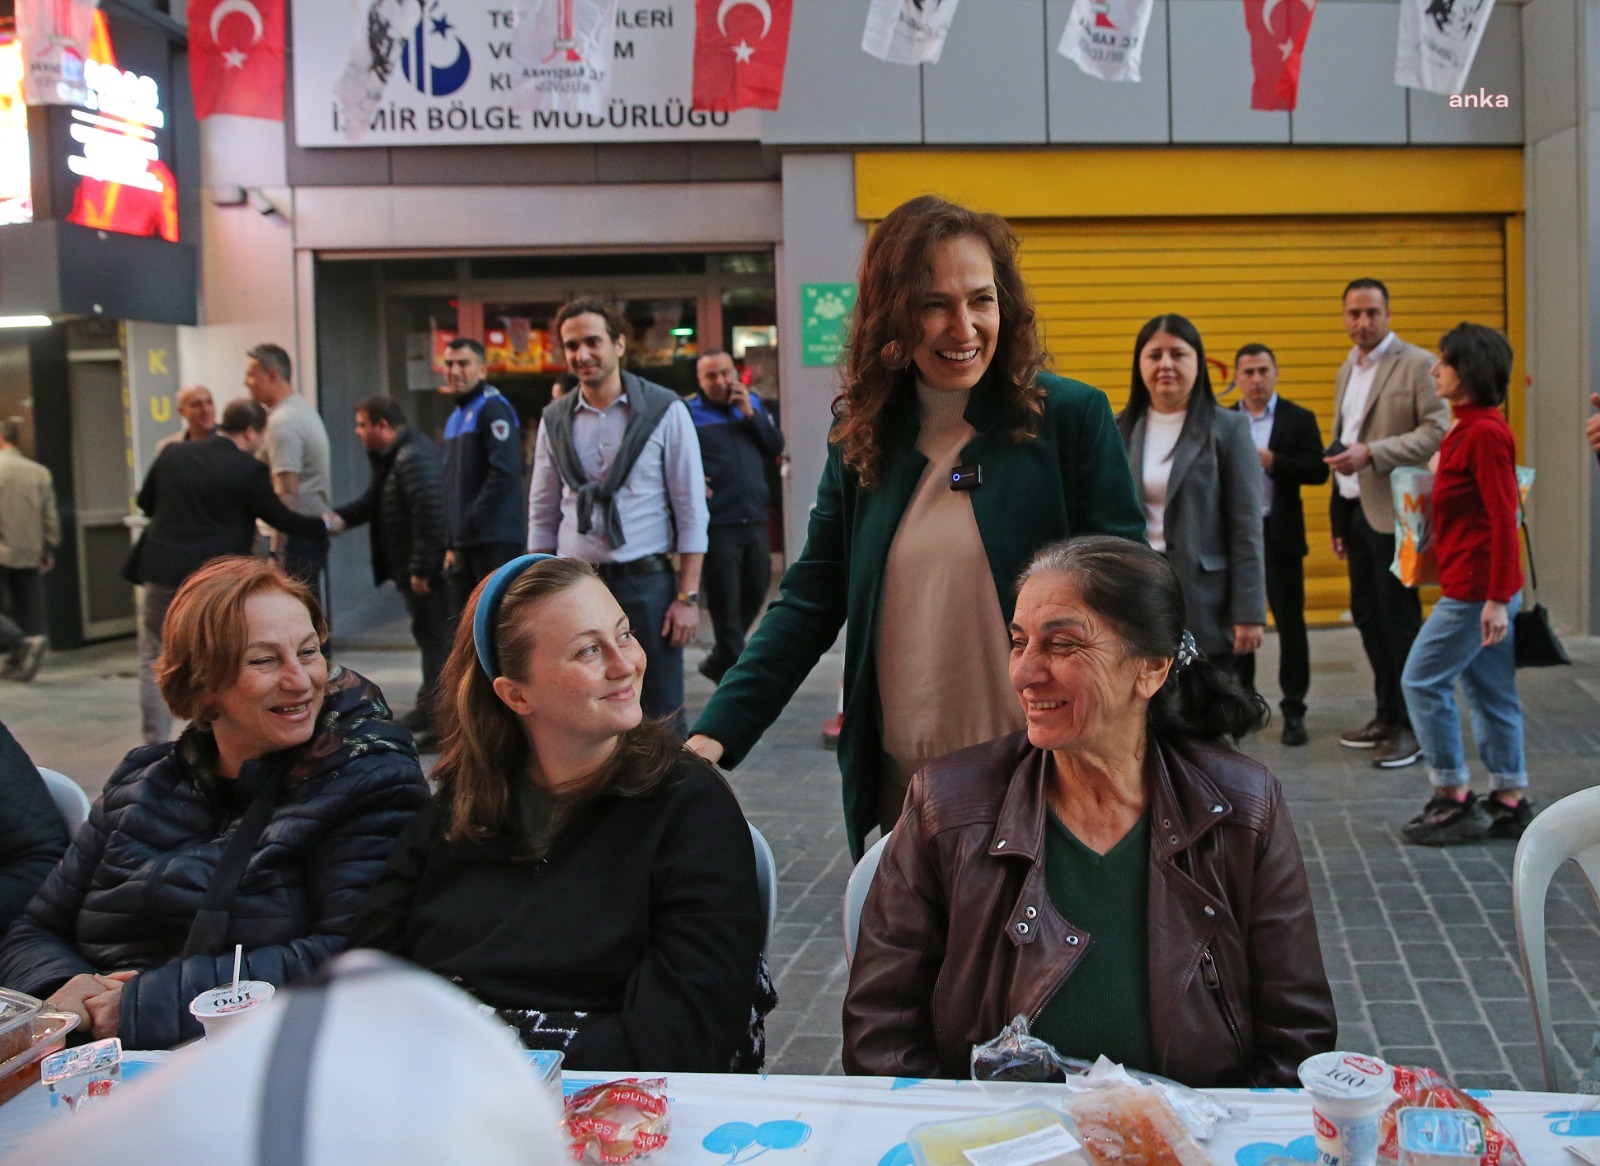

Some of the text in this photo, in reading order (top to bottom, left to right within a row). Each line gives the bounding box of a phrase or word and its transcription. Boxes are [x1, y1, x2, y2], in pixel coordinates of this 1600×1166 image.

[333, 102, 417, 131] İMİR
[427, 100, 521, 130] BÖLGE
[1326, 1069, 1365, 1088] 100
[613, 1091, 657, 1109] sanek
